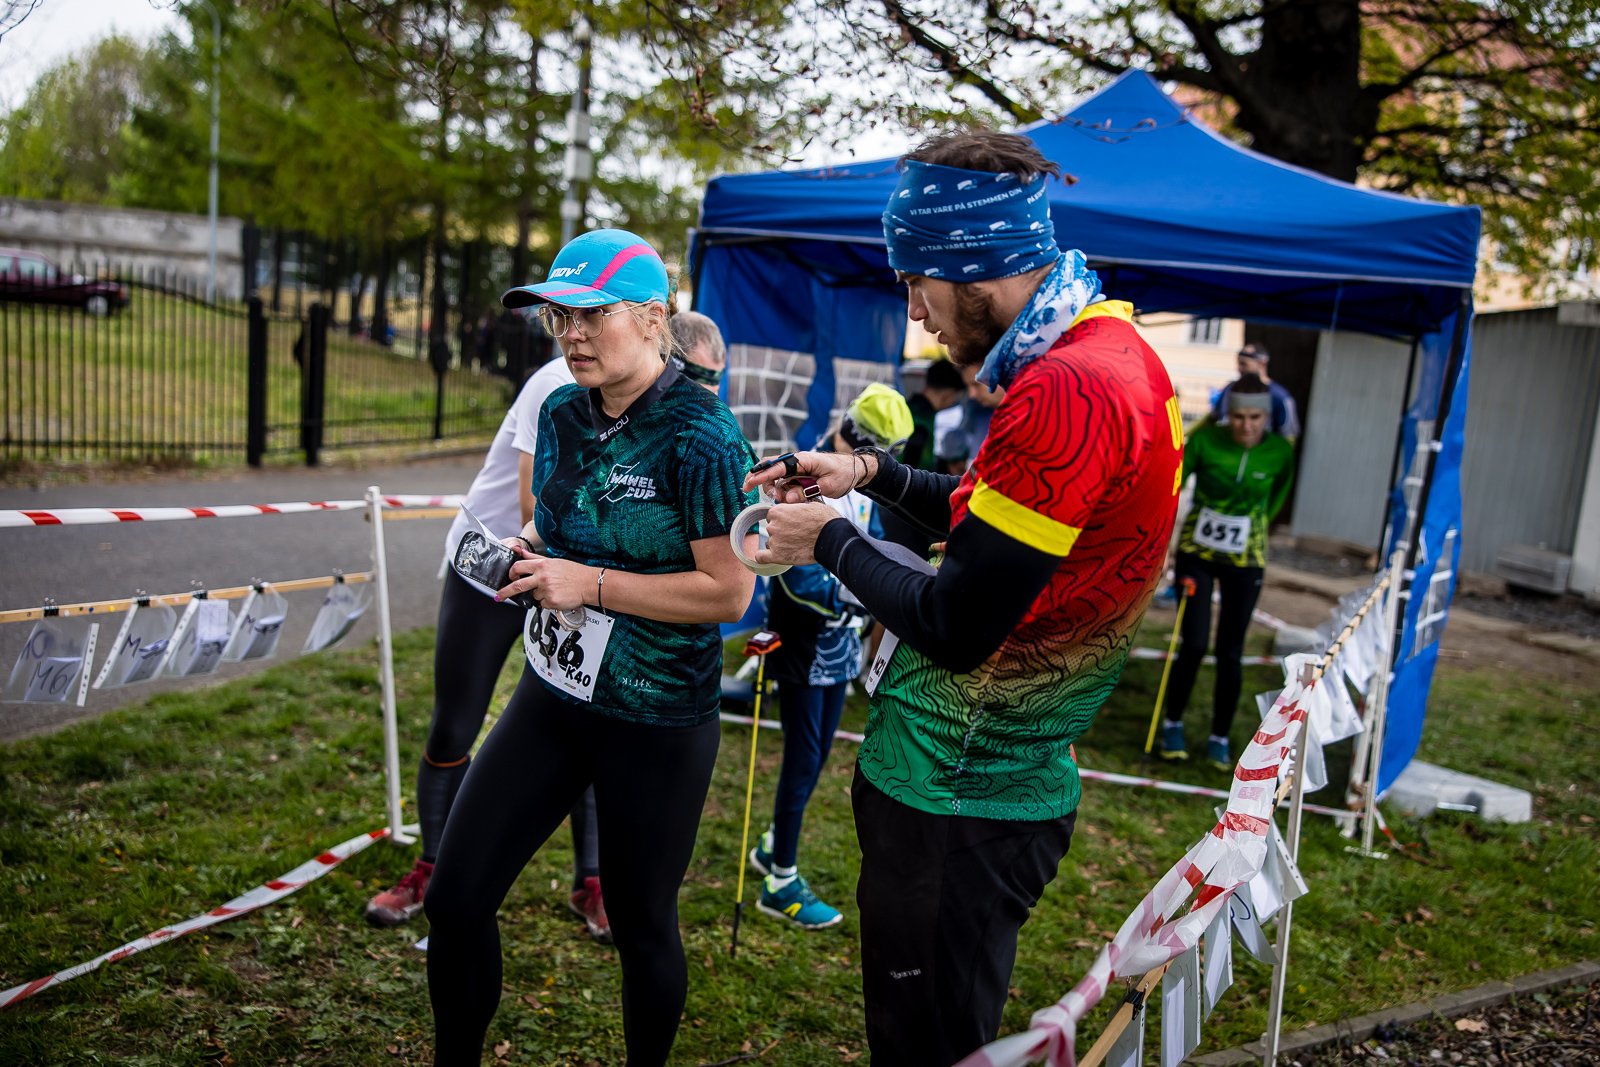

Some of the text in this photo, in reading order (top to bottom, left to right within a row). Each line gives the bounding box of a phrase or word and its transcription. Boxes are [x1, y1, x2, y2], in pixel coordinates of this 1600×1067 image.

[918, 207, 932, 216] TAR
[933, 204, 954, 214] VARE
[967, 191, 1008, 209] STEMMEN
[1008, 187, 1023, 198] DIN
[1019, 261, 1035, 274] DIN
[609, 472, 657, 490] WAWEL
[626, 486, 656, 500] CUP
[565, 664, 592, 688] K40
